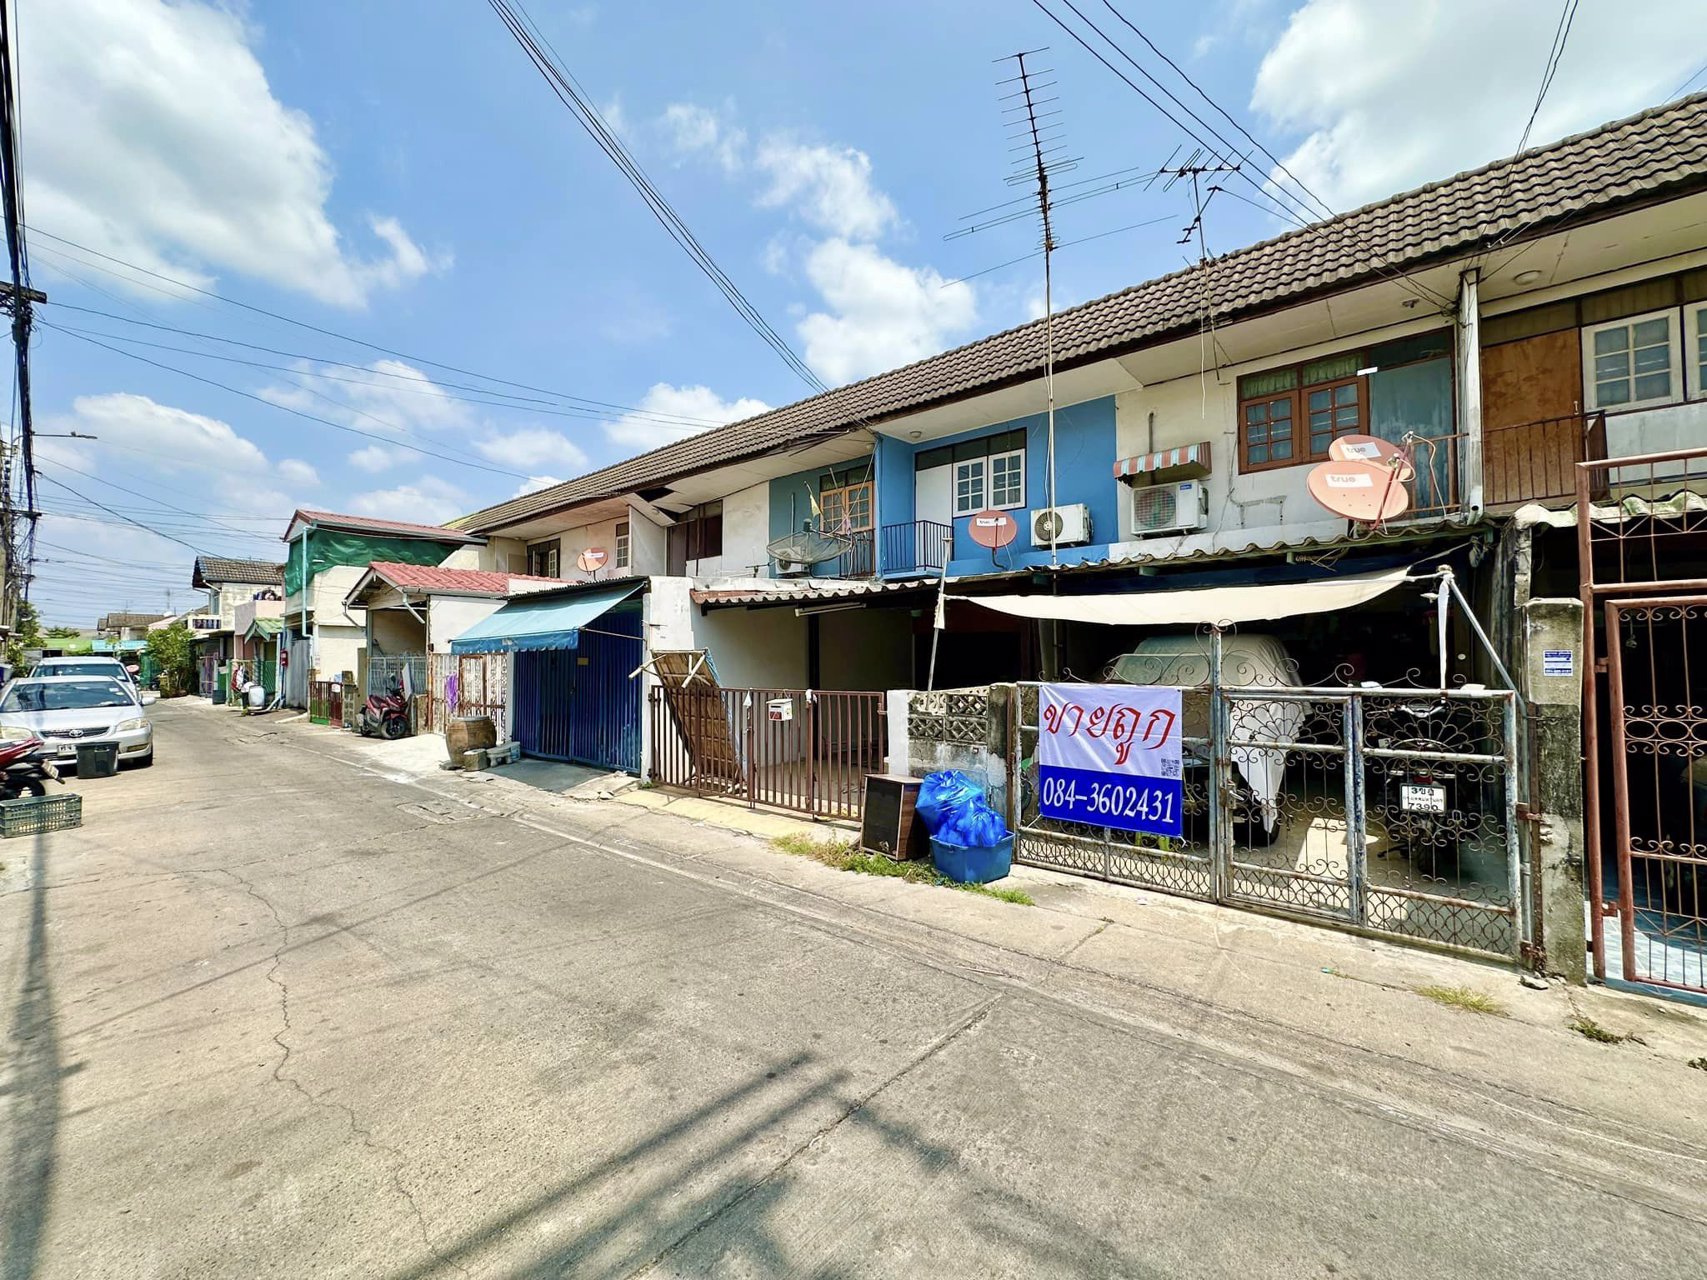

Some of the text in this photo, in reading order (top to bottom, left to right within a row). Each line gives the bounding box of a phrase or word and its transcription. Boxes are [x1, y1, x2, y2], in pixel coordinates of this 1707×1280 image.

[1330, 475, 1356, 483] true
[1043, 701, 1176, 766] ขายถูก
[1043, 777, 1175, 823] 084-3602431
